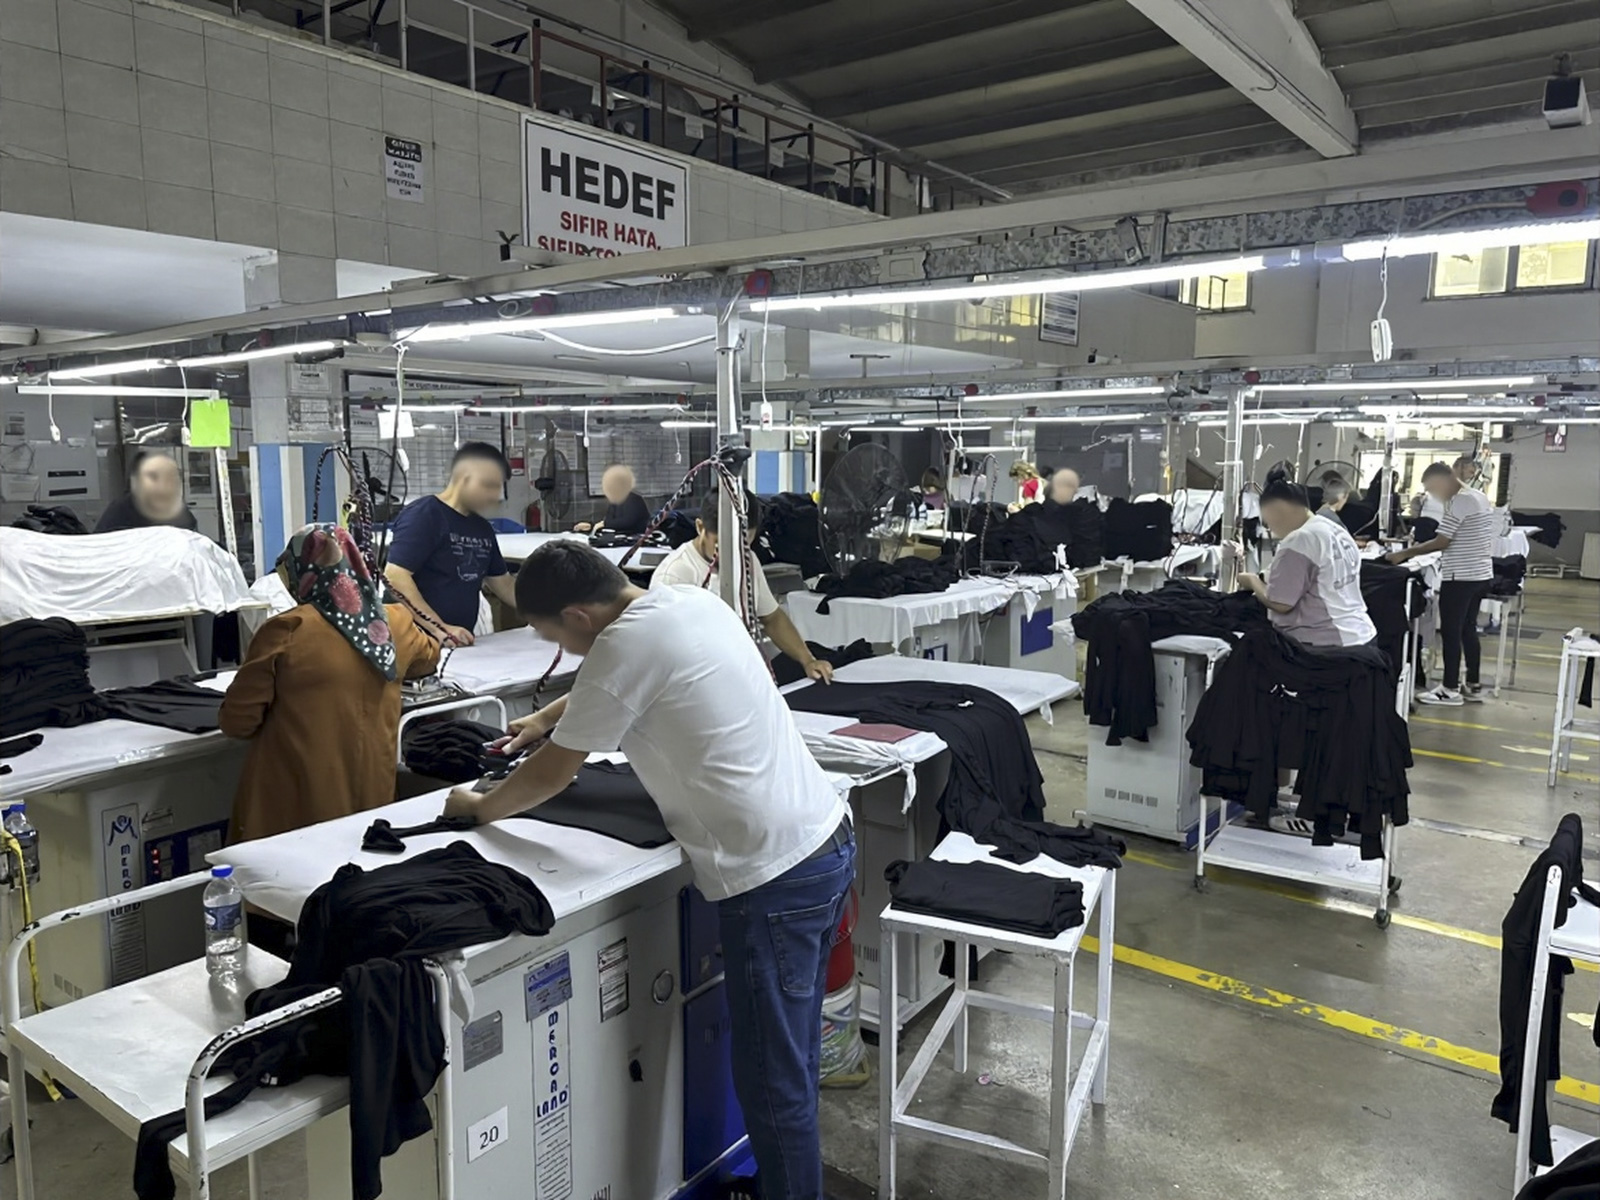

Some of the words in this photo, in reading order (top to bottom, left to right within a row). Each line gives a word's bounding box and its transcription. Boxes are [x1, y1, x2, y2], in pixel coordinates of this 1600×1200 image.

[540, 146, 676, 221] HEDEF
[560, 210, 609, 240] SIFIR
[479, 1125, 499, 1150] 20
